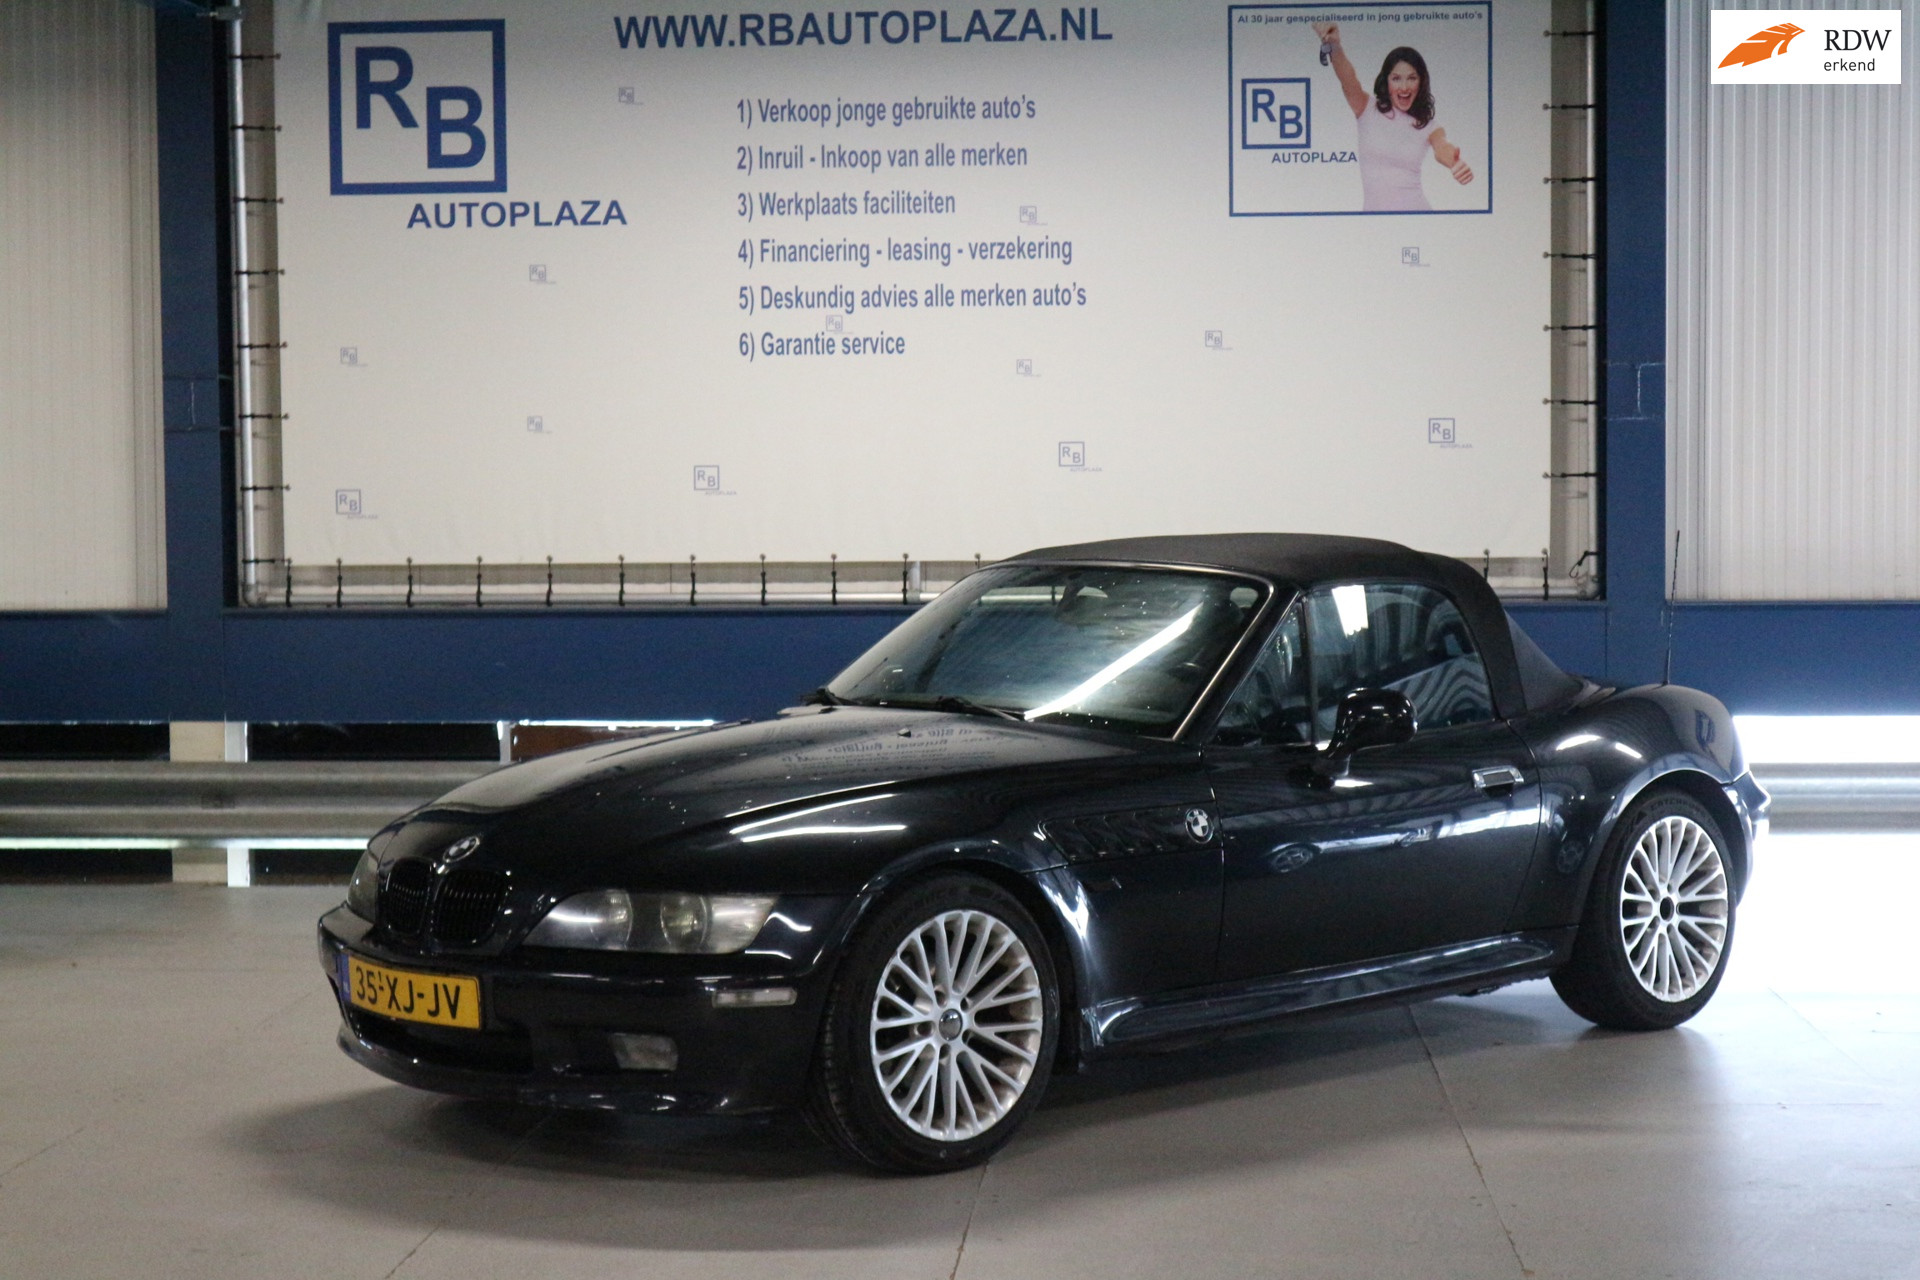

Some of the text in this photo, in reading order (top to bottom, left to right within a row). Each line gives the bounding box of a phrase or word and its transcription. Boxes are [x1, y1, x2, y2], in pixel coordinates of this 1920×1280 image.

[614, 8, 1112, 49] WWW.RBAUTOPLAZA.NL
[1238, 11, 1483, 25] Al 30 jaar gespecialiseerd in jong gebruikte auto's
[355, 46, 487, 169] RB
[737, 95, 1036, 129] 1) Verkoop jonge gebruikte auto's
[1251, 88, 1303, 140] RB
[737, 145, 753, 176] 2)
[759, 145, 804, 169] Inruil
[821, 144, 882, 173] Inkoop
[887, 149, 919, 167] van
[925, 143, 955, 167] alle
[962, 142, 1028, 166] merken
[1271, 151, 1357, 164] AUTOPLAZA
[407, 200, 627, 229] AUTOPLAZA
[737, 190, 956, 222] 3) Werkplaats faciliteiten
[738, 239, 754, 269] 4)
[761, 238, 870, 268] Financiering
[888, 237, 951, 266] leasing
[969, 236, 1073, 265] verzekering
[739, 282, 1087, 316] 5) Deskundig advies alle merken auto's
[739, 331, 906, 363] 6) Garantie service
